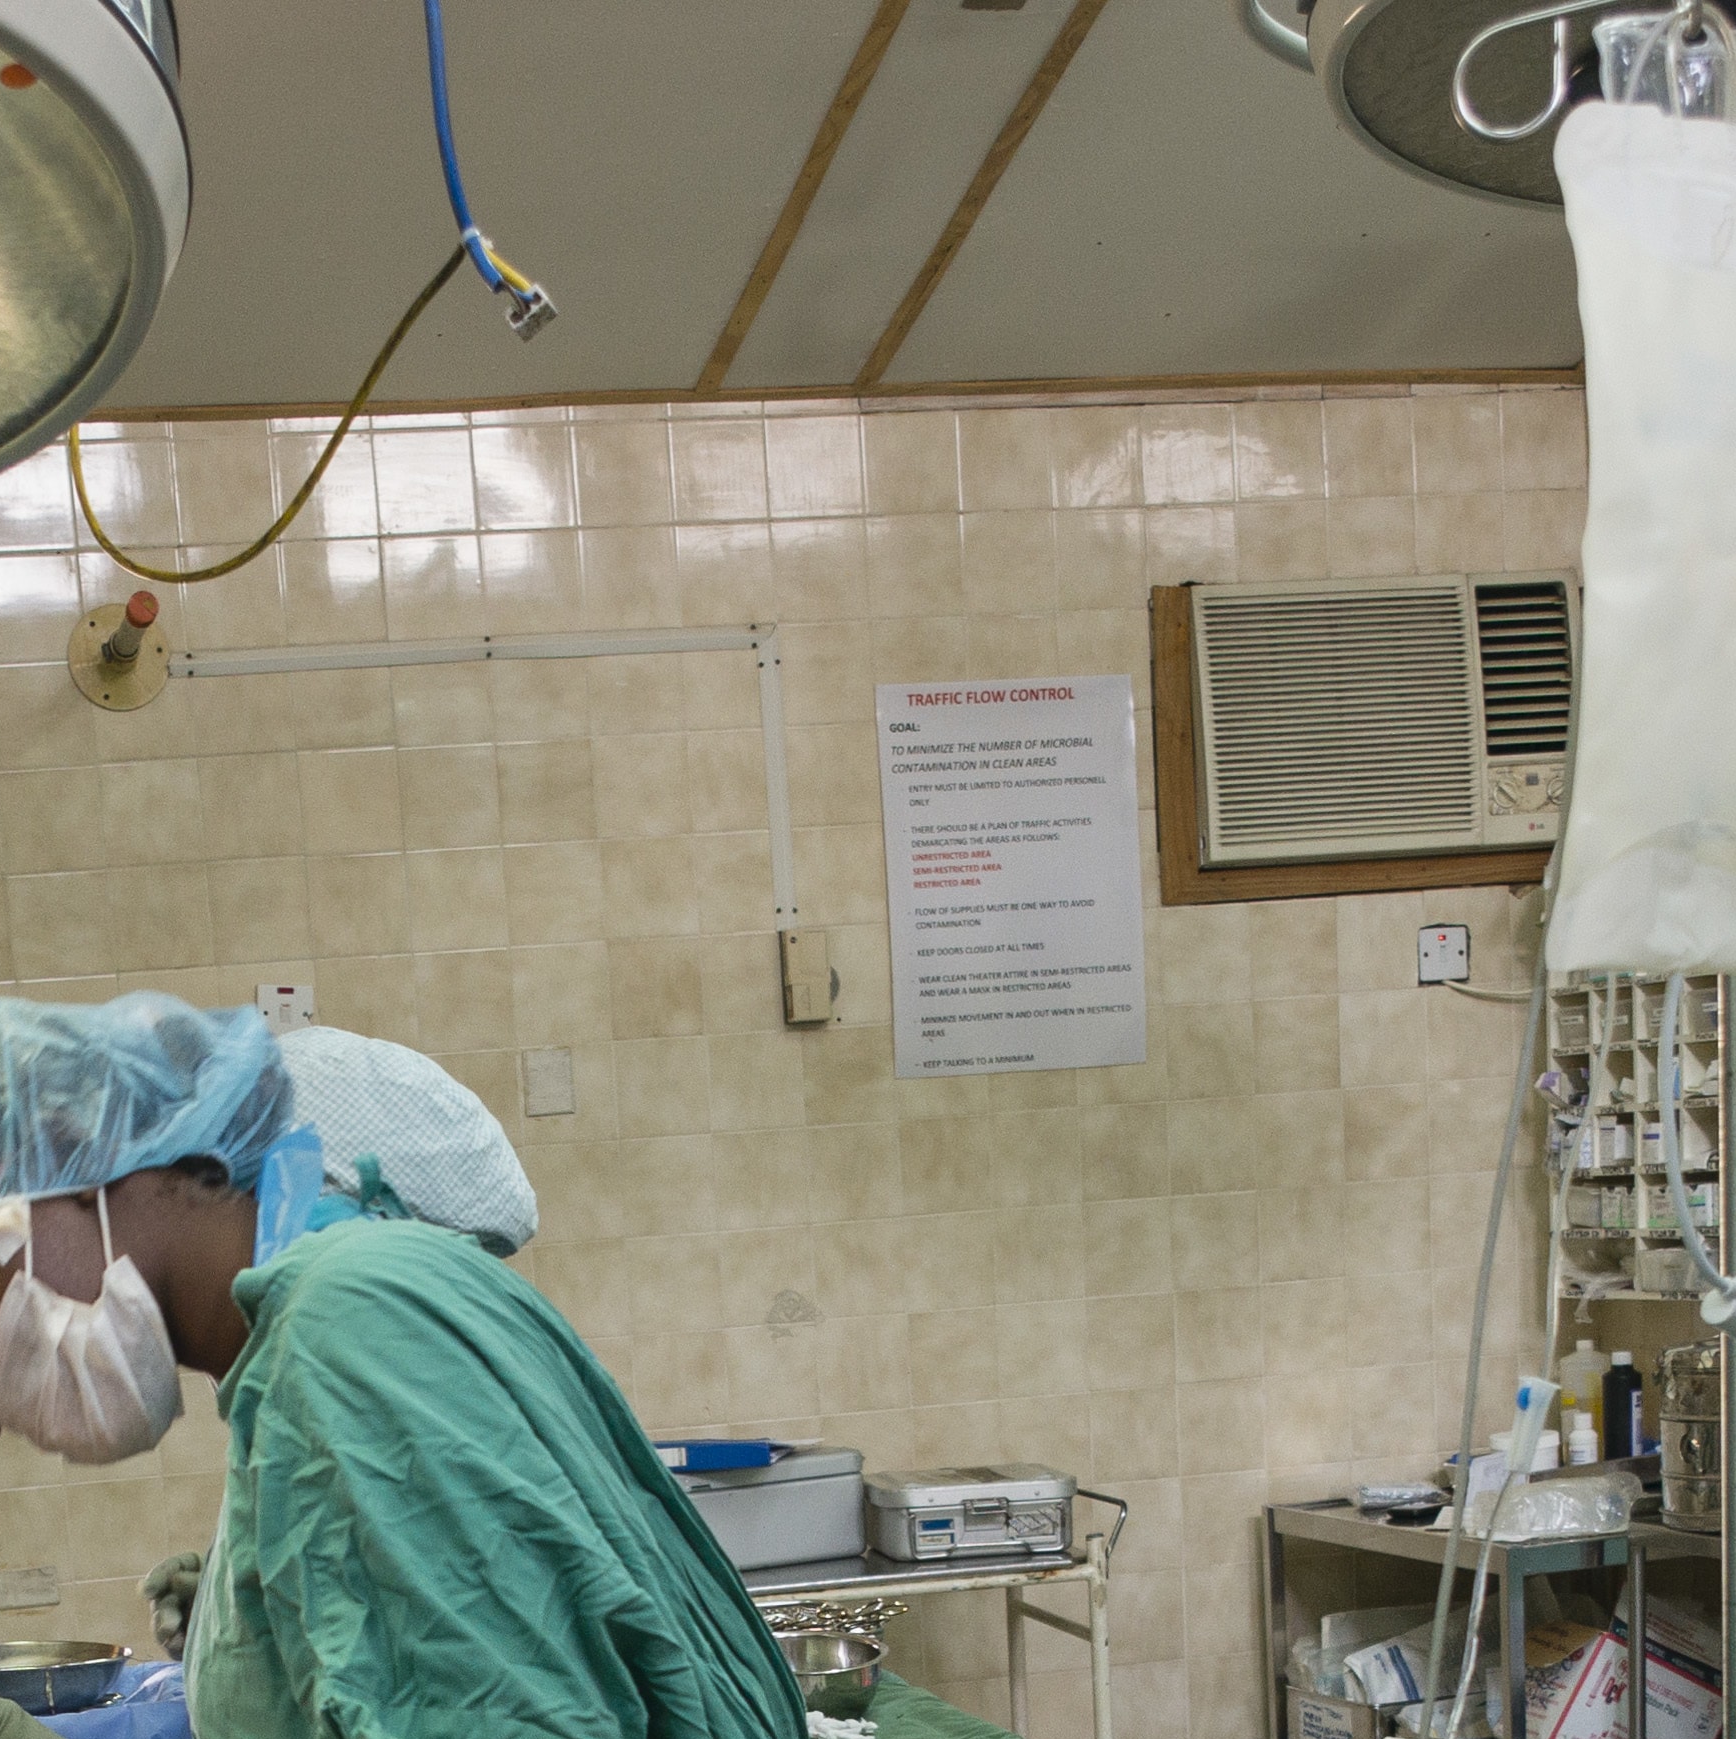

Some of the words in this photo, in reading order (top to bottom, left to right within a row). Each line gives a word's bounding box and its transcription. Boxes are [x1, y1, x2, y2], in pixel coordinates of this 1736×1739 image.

[906, 691, 963, 707] TRAFFIC
[966, 690, 1006, 704] FLOW
[1010, 687, 1075, 702] CONTROL
[889, 722, 921, 733] GOAL:
[891, 746, 905, 756] TO
[906, 744, 954, 756] MINIMIZE
[958, 743, 977, 753] THE
[978, 740, 1022, 752] NUMBER
[1024, 739, 1038, 750] OF
[1040, 737, 1093, 749] MICROBIAL
[891, 760, 977, 774] CONTAMINATION
[979, 760, 990, 769] IN
[992, 758, 1024, 769] CLEAN
[1025, 756, 1057, 768] AREAS
[908, 784, 933, 794] ENTRY
[934, 783, 957, 793] MUST
[958, 782, 968, 791] BE
[970, 780, 1001, 791] LIMITED
[1003, 780, 1013, 789] TO
[1014, 778, 1062, 789] AUTHORIZED
[1064, 776, 1106, 786] PERSONELL
[909, 798, 930, 807] ONLY
[910, 825, 935, 835] THERE
[936, 823, 968, 834] SHOULD
[969, 823, 979, 832] BE
[980, 822, 987, 831] A
[988, 821, 1008, 831] PLAN
[1009, 820, 1020, 830] OF
[1021, 819, 1051, 829] TRAFFIC
[1052, 817, 1092, 827] ACTIVITIES
[911, 836, 968, 848] DEMARCATING
[969, 836, 985, 845] THE
[986, 835, 1010, 844] AREAS
[1011, 834, 1021, 842] AS
[1022, 832, 1061, 842] FOLLOWS:
[911, 851, 969, 862] UNRESTRICTED
[970, 850, 992, 859] AREA
[912, 864, 980, 875] SEMI-RESTRICTED
[981, 863, 1002, 872] AREA
[913, 878, 959, 889] RESTRICTED
[960, 877, 981, 887] AREA
[915, 907, 937, 917] FLOW
[938, 907, 949, 916] OF
[950, 905, 985, 915] SUPPLIES
[986, 903, 1009, 913] MUST
[1010, 902, 1019, 911] BE
[1021, 901, 1037, 911] ONE
[1039, 901, 1057, 910] WAY
[1058, 900, 1069, 909] TO
[1070, 899, 1095, 908] AVOID
[915, 918, 981, 930] CONTAMINATION
[916, 948, 935, 957] KEEP
[936, 947, 964, 957] DOORS
[965, 945, 994, 955] CLOSED
[995, 944, 1005, 953] AT
[1006, 943, 1020, 952] ALL
[1021, 942, 1045, 951] TIMES
[918, 975, 941, 985] WEAR
[942, 974, 967, 983] CLEAN
[968, 972, 1002, 982] THEATER
[1002, 970, 1029, 980] ATTIRE
[1030, 969, 1039, 978] IN
[1040, 966, 1106, 977] SEMI-RESTRICTED
[1106, 964, 1132, 973] AREAS
[919, 989, 936, 998] AND
[937, 987, 960, 997] WEAR
[961, 987, 968, 995] A
[968, 985, 991, 995] MASK
[992, 984, 1001, 993] IN
[1002, 983, 1047, 993] RESTRICTED
[1047, 981, 1072, 990] AREAS
[920, 1014, 957, 1025] MINIMIZE
[958, 1012, 1004, 1023] MOVEMENT
[1005, 1011, 1014, 1020] IN
[1015, 1010, 1032, 1019] AND
[1033, 1009, 1050, 1018] OUT
[1051, 1008, 1075, 1017] WHEN
[1076, 1007, 1085, 1015] IN
[921, 1029, 946, 1038] AREAS
[923, 1060, 942, 1069] KEEP
[942, 1058, 975, 1068] TALKING
[976, 1056, 987, 1066] TO
[987, 1056, 994, 1064] A
[995, 1054, 1035, 1064] MINIMUM
